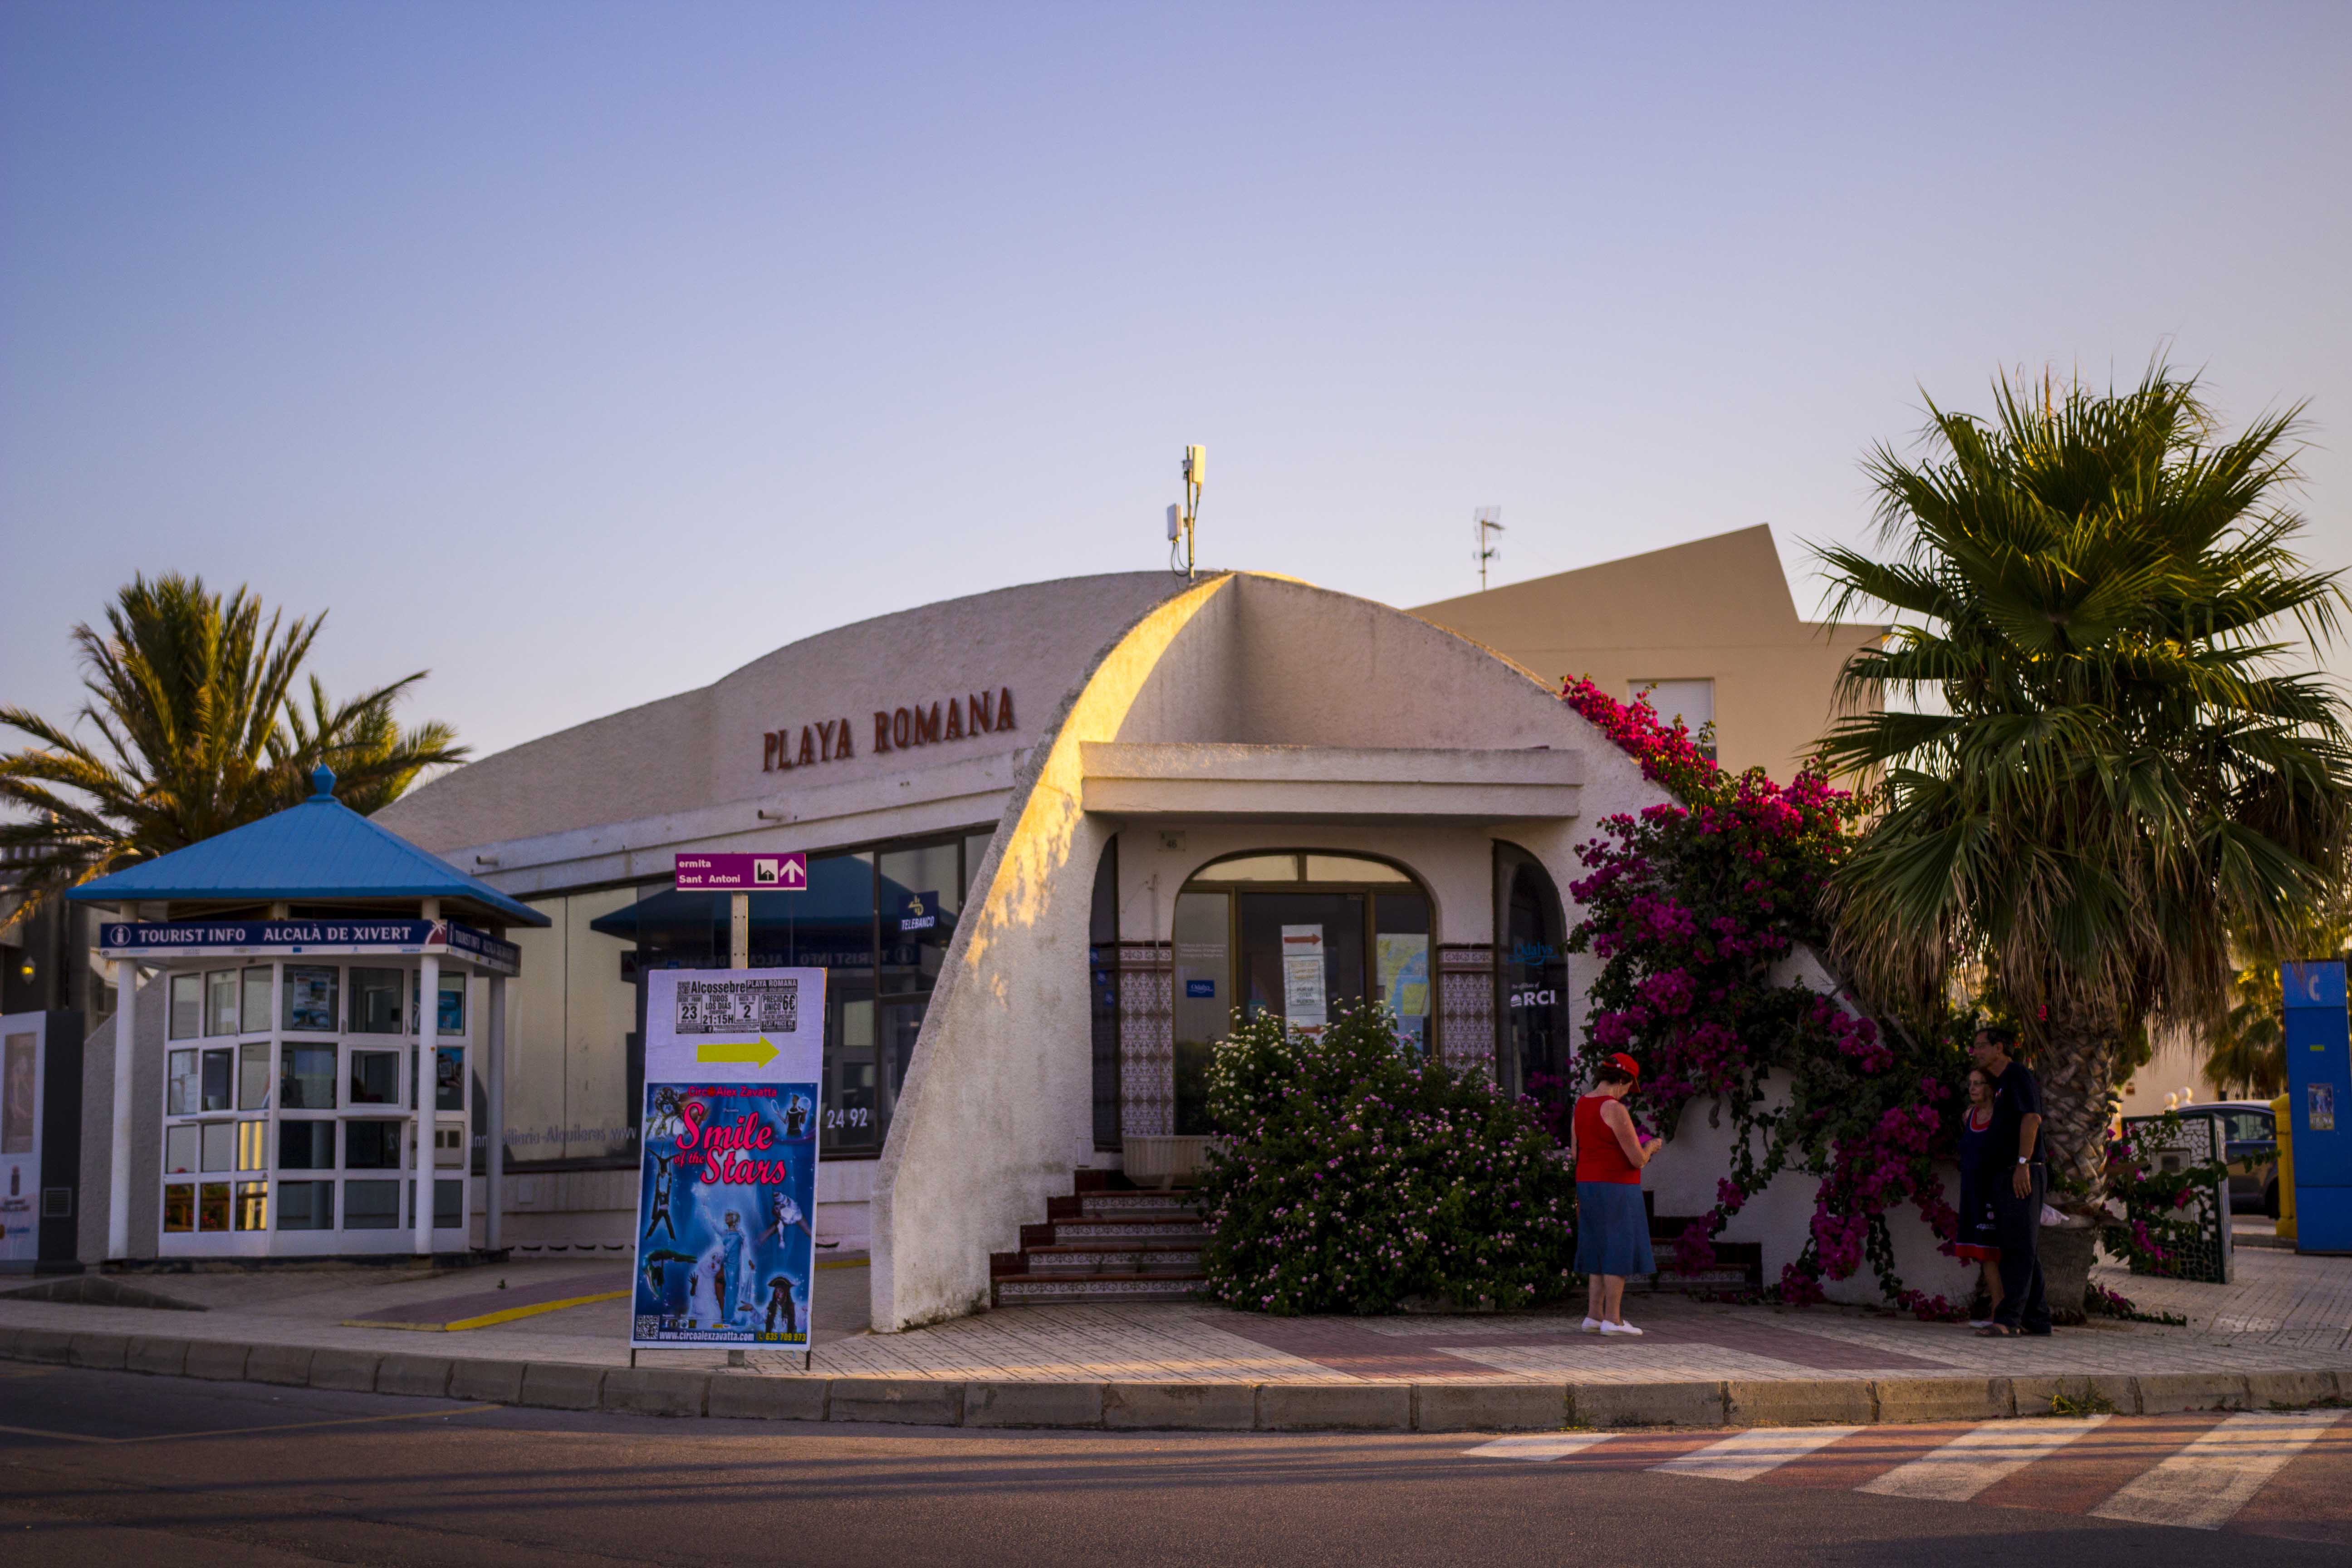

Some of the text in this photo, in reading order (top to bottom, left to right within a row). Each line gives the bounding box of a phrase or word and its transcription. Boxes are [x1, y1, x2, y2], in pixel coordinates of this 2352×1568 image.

[763, 687, 1014, 772] PLAYA ROMANA
[679, 859, 711, 868] ermita
[679, 874, 741, 883] Sant Antoni
[902, 916, 935, 930] TELEBANCO
[139, 924, 412, 943] TOURIST INFO ALCALÀ DE XIVERT
[691, 980, 745, 994] Alcossebre
[769, 979, 797, 987] ROMANA
[783, 995, 795, 1010] 6€
[1524, 990, 1555, 1006] RCI
[682, 1006, 697, 1019] 23
[702, 1014, 734, 1024] 21:15H
[743, 1005, 751, 1018] 2
[715, 1086, 737, 1097] Alex
[740, 1086, 777, 1097] Zavatta
[827, 1107, 867, 1128] 24 92
[675, 1102, 774, 1150] Smile
[673, 1150, 705, 1169] of the
[700, 1145, 786, 1185] Stars
[659, 1330, 755, 1341] www.circoalexzavatta.com
[765, 1332, 778, 1341] 635
[794, 1333, 806, 1342] 973
